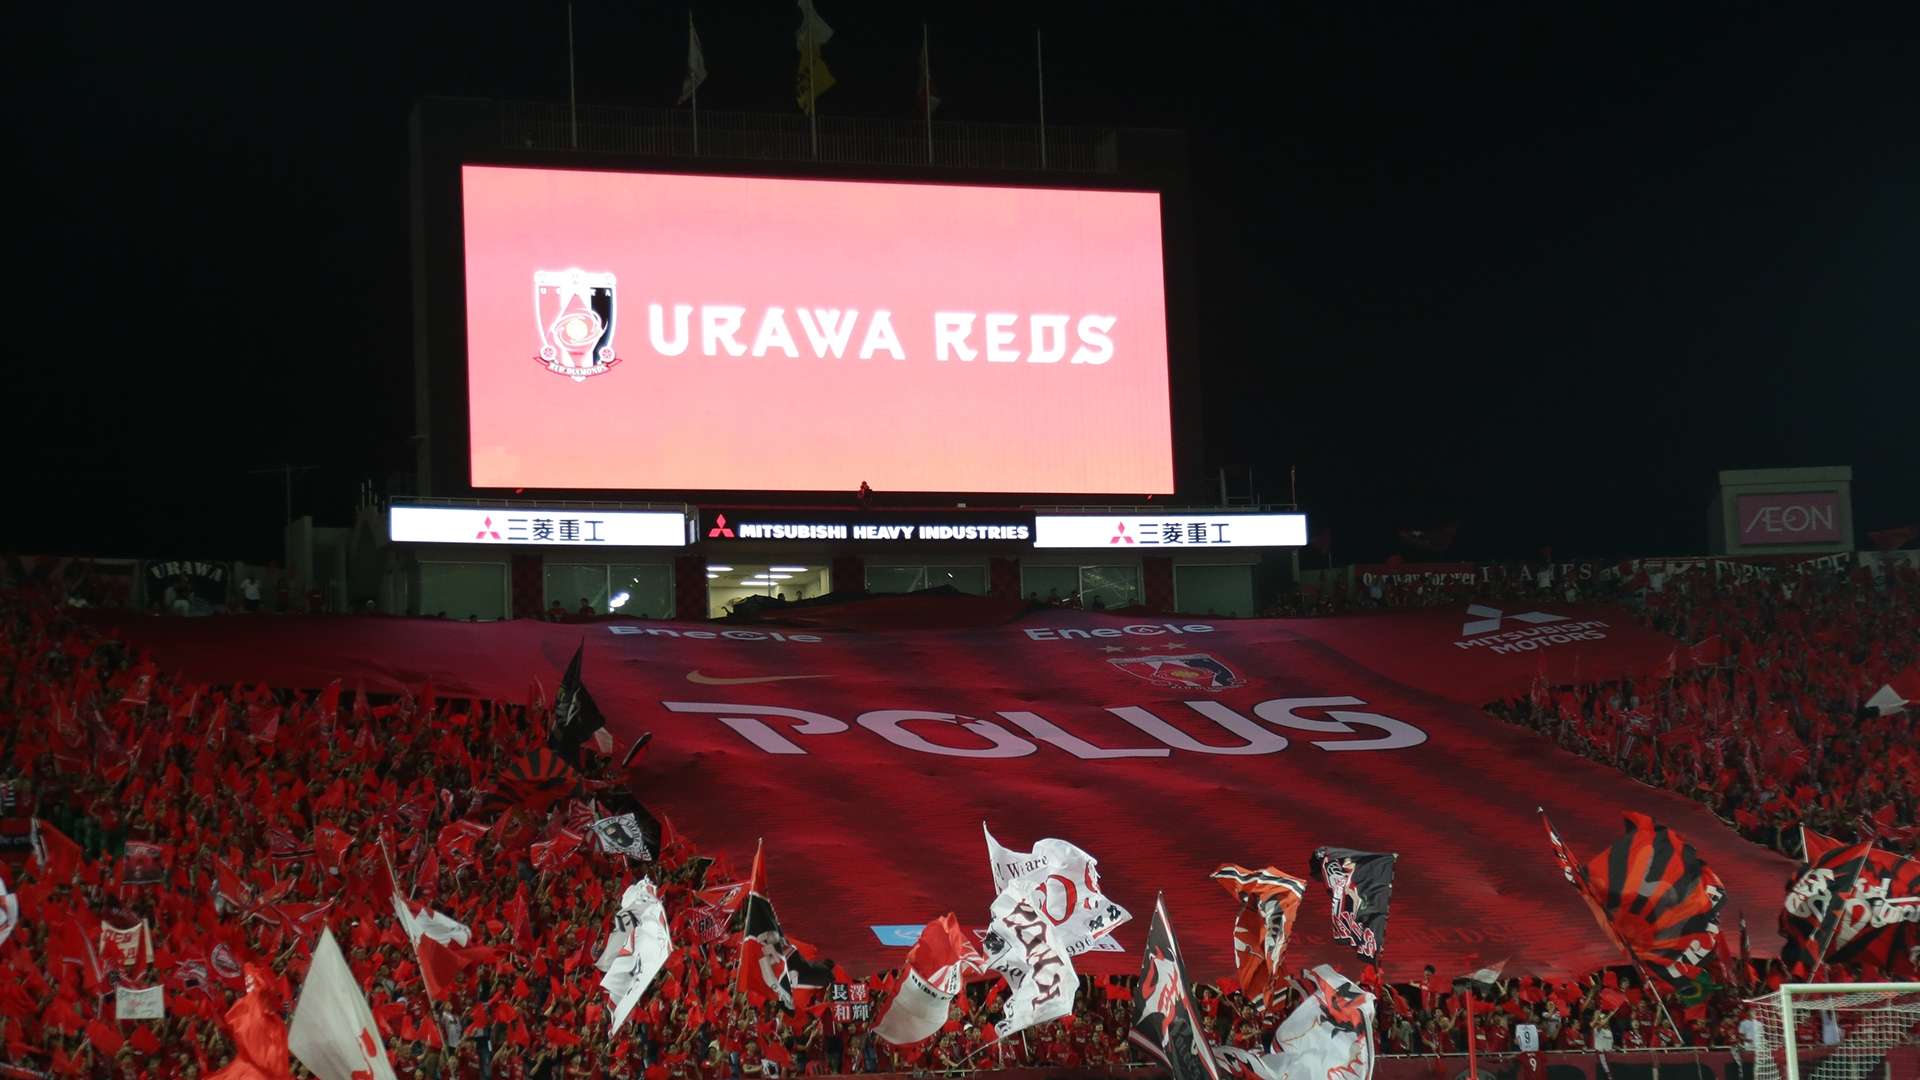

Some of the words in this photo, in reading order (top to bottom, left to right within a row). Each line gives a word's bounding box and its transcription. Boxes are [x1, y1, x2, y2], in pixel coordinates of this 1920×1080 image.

[647, 303, 906, 361] URAWA
[934, 311, 1118, 365] REDS
[506, 518, 606, 542] 三菱重工
[738, 523, 848, 540] MITSUBISHI
[853, 525, 914, 540] HEAVY
[918, 525, 1029, 540] INDUSTRIES
[1138, 522, 1231, 544] 三菱重工
[151, 561, 222, 582] URAWA
[1361, 571, 1389, 586] Or
[1453, 620, 1611, 650] MITSUBISHI
[1489, 630, 1608, 655] MOTORS
[661, 695, 1428, 759] POLUS
[1523, 1030, 1531, 1044] 9
[1528, 1057, 1537, 1072] 9
